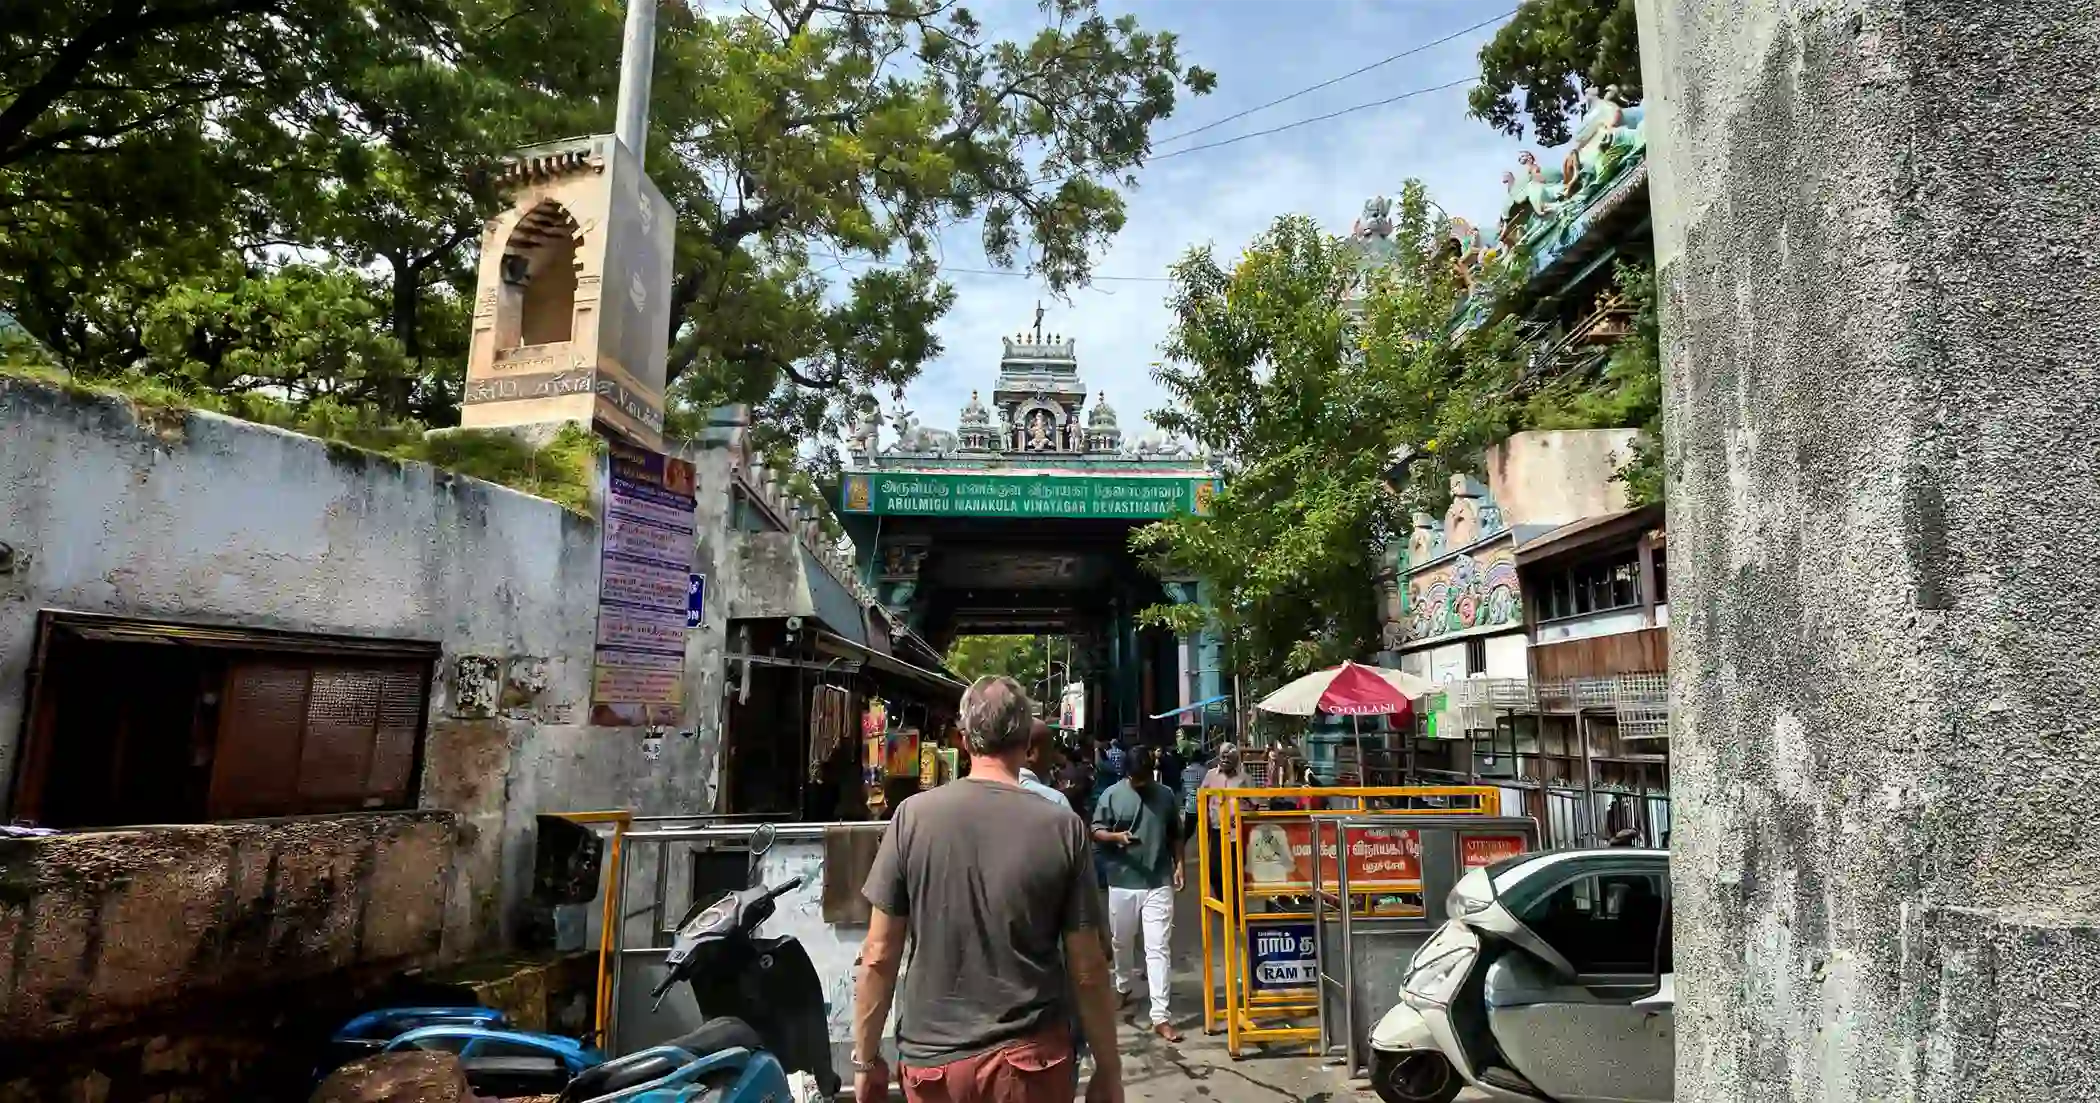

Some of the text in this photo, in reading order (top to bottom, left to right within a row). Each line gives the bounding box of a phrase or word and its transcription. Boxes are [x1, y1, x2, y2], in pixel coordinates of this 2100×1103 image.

[888, 498, 949, 511] ARULMIGU
[954, 499, 1017, 512] MANAKULA
[1024, 500, 1086, 513] VINAYAGAR
[1264, 967, 1298, 979] RAM
